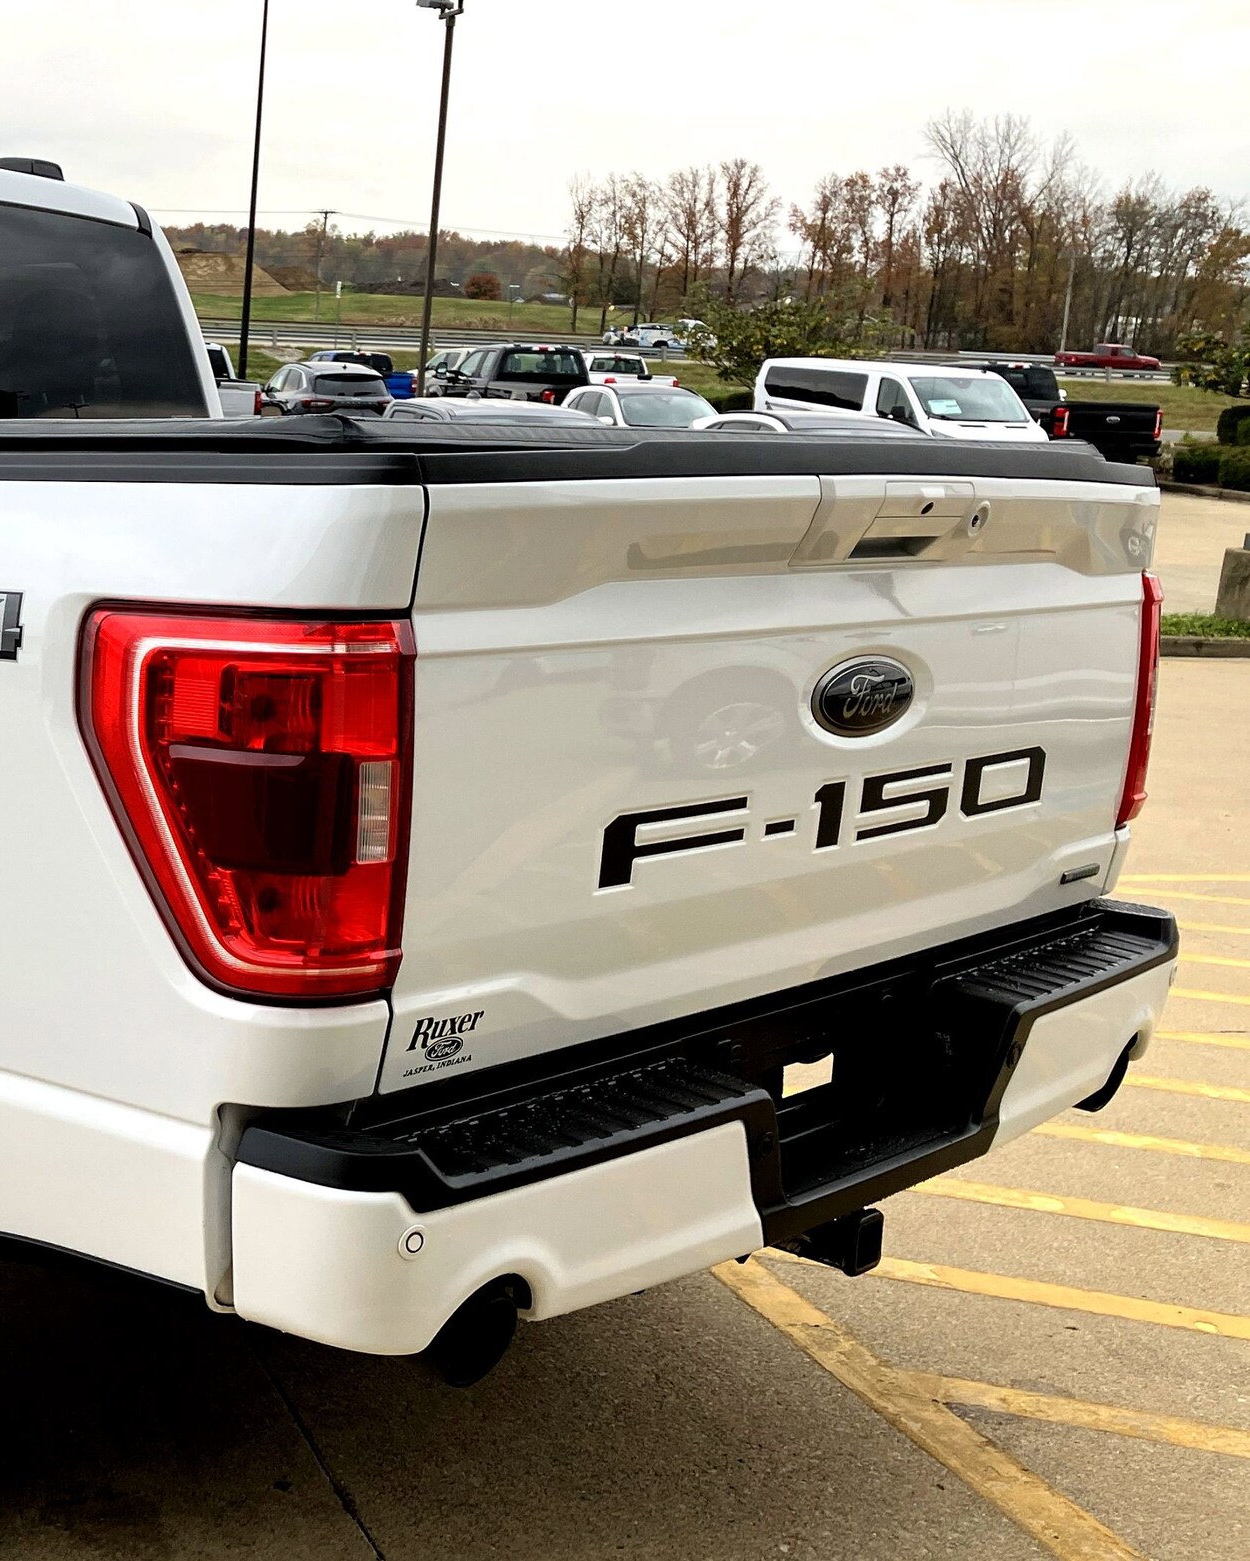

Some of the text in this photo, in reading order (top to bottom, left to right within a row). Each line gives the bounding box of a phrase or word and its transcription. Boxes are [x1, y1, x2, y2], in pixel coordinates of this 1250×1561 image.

[842, 674, 899, 719] Ford
[598, 746, 1046, 889] F-150
[406, 1010, 484, 1051] Ruxer
[430, 1040, 459, 1057] Ford
[403, 1055, 472, 1077] JASPER, INDIANA
